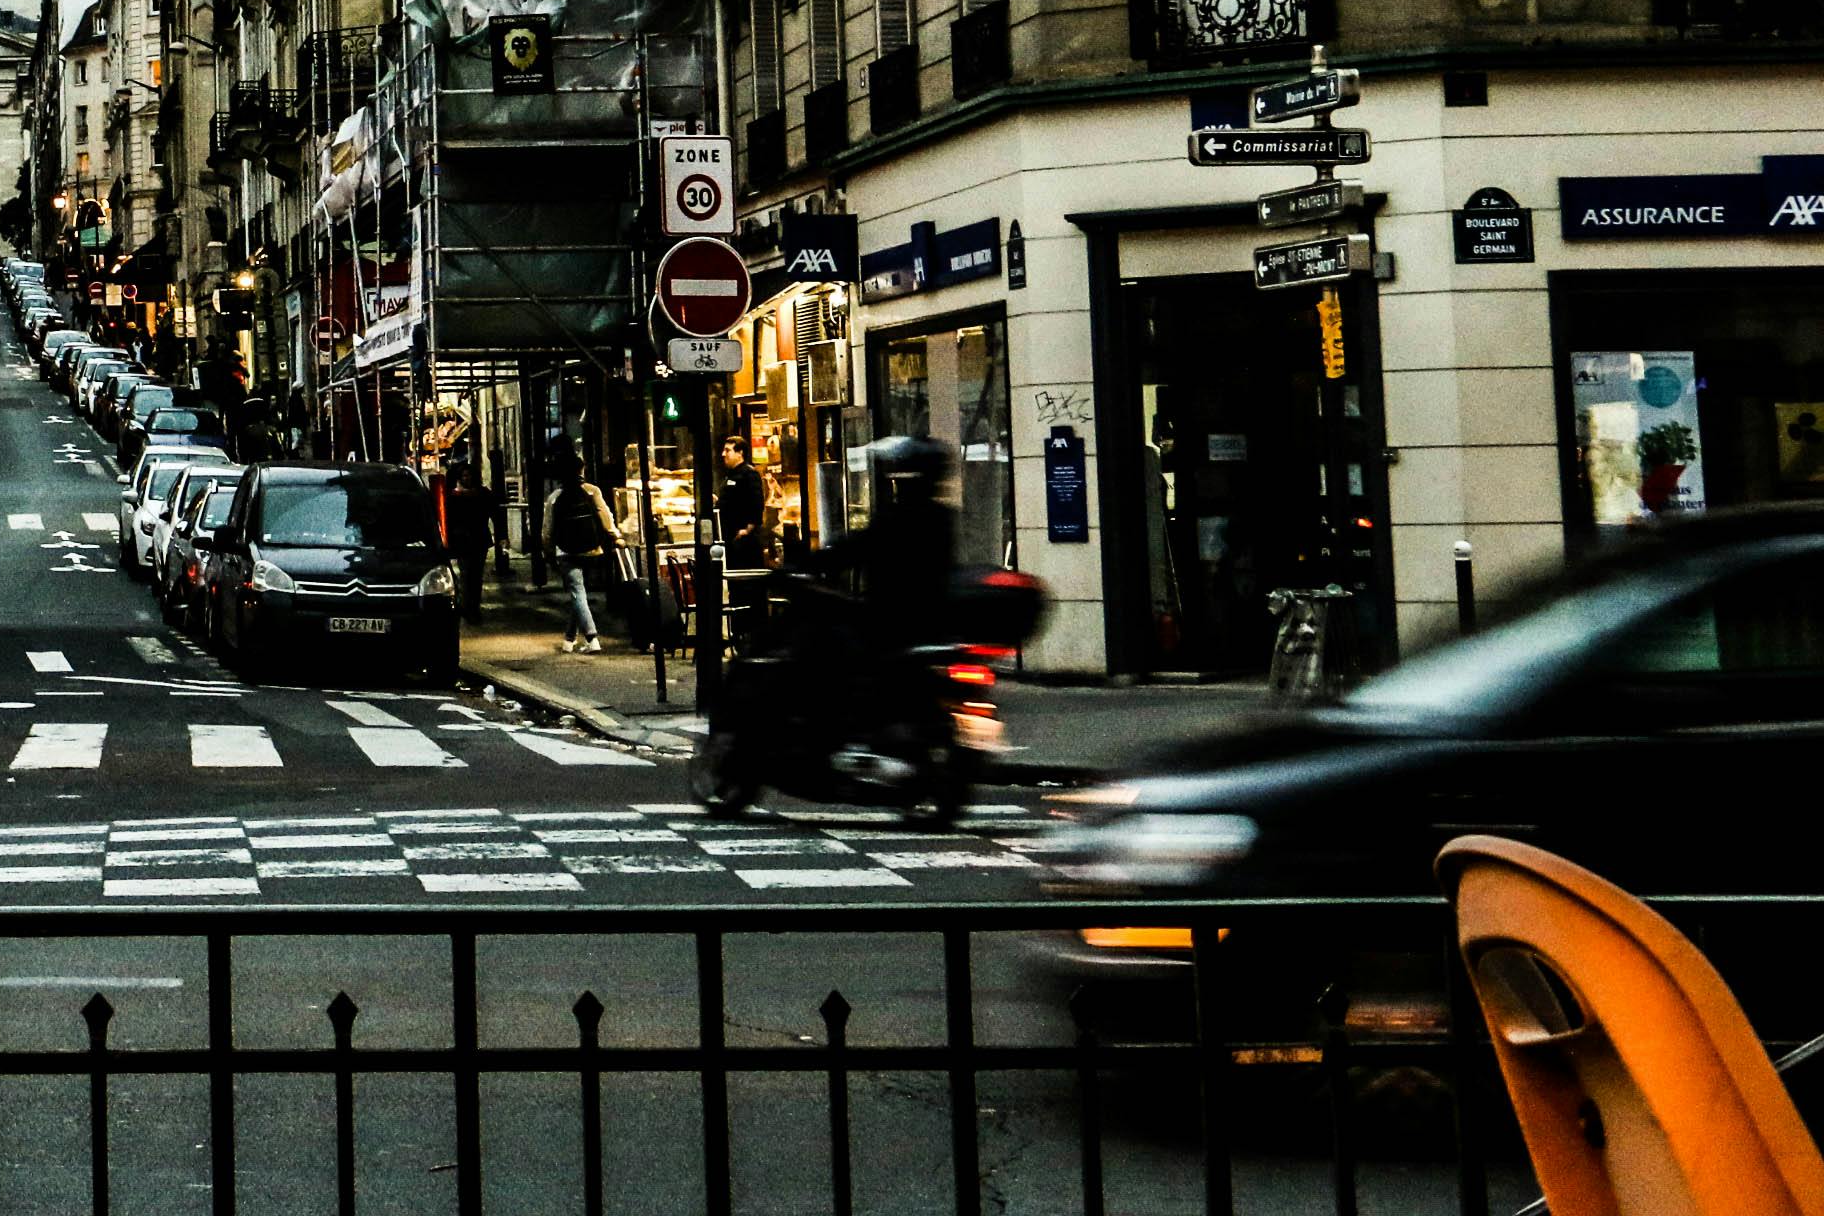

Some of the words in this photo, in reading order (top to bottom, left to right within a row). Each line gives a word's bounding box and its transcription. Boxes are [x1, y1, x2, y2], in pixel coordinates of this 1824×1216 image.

[1232, 140, 1333, 152] Commissariat
[675, 149, 721, 163] ZONE
[686, 187, 713, 208] 30
[1581, 206, 1725, 226] ASSURANCE
[1465, 217, 1520, 228] BOULEVARD
[1480, 231, 1507, 241] SAINT
[1473, 245, 1516, 255] GERMAIN
[786, 248, 838, 273] AXA
[691, 343, 721, 351] SAUF
